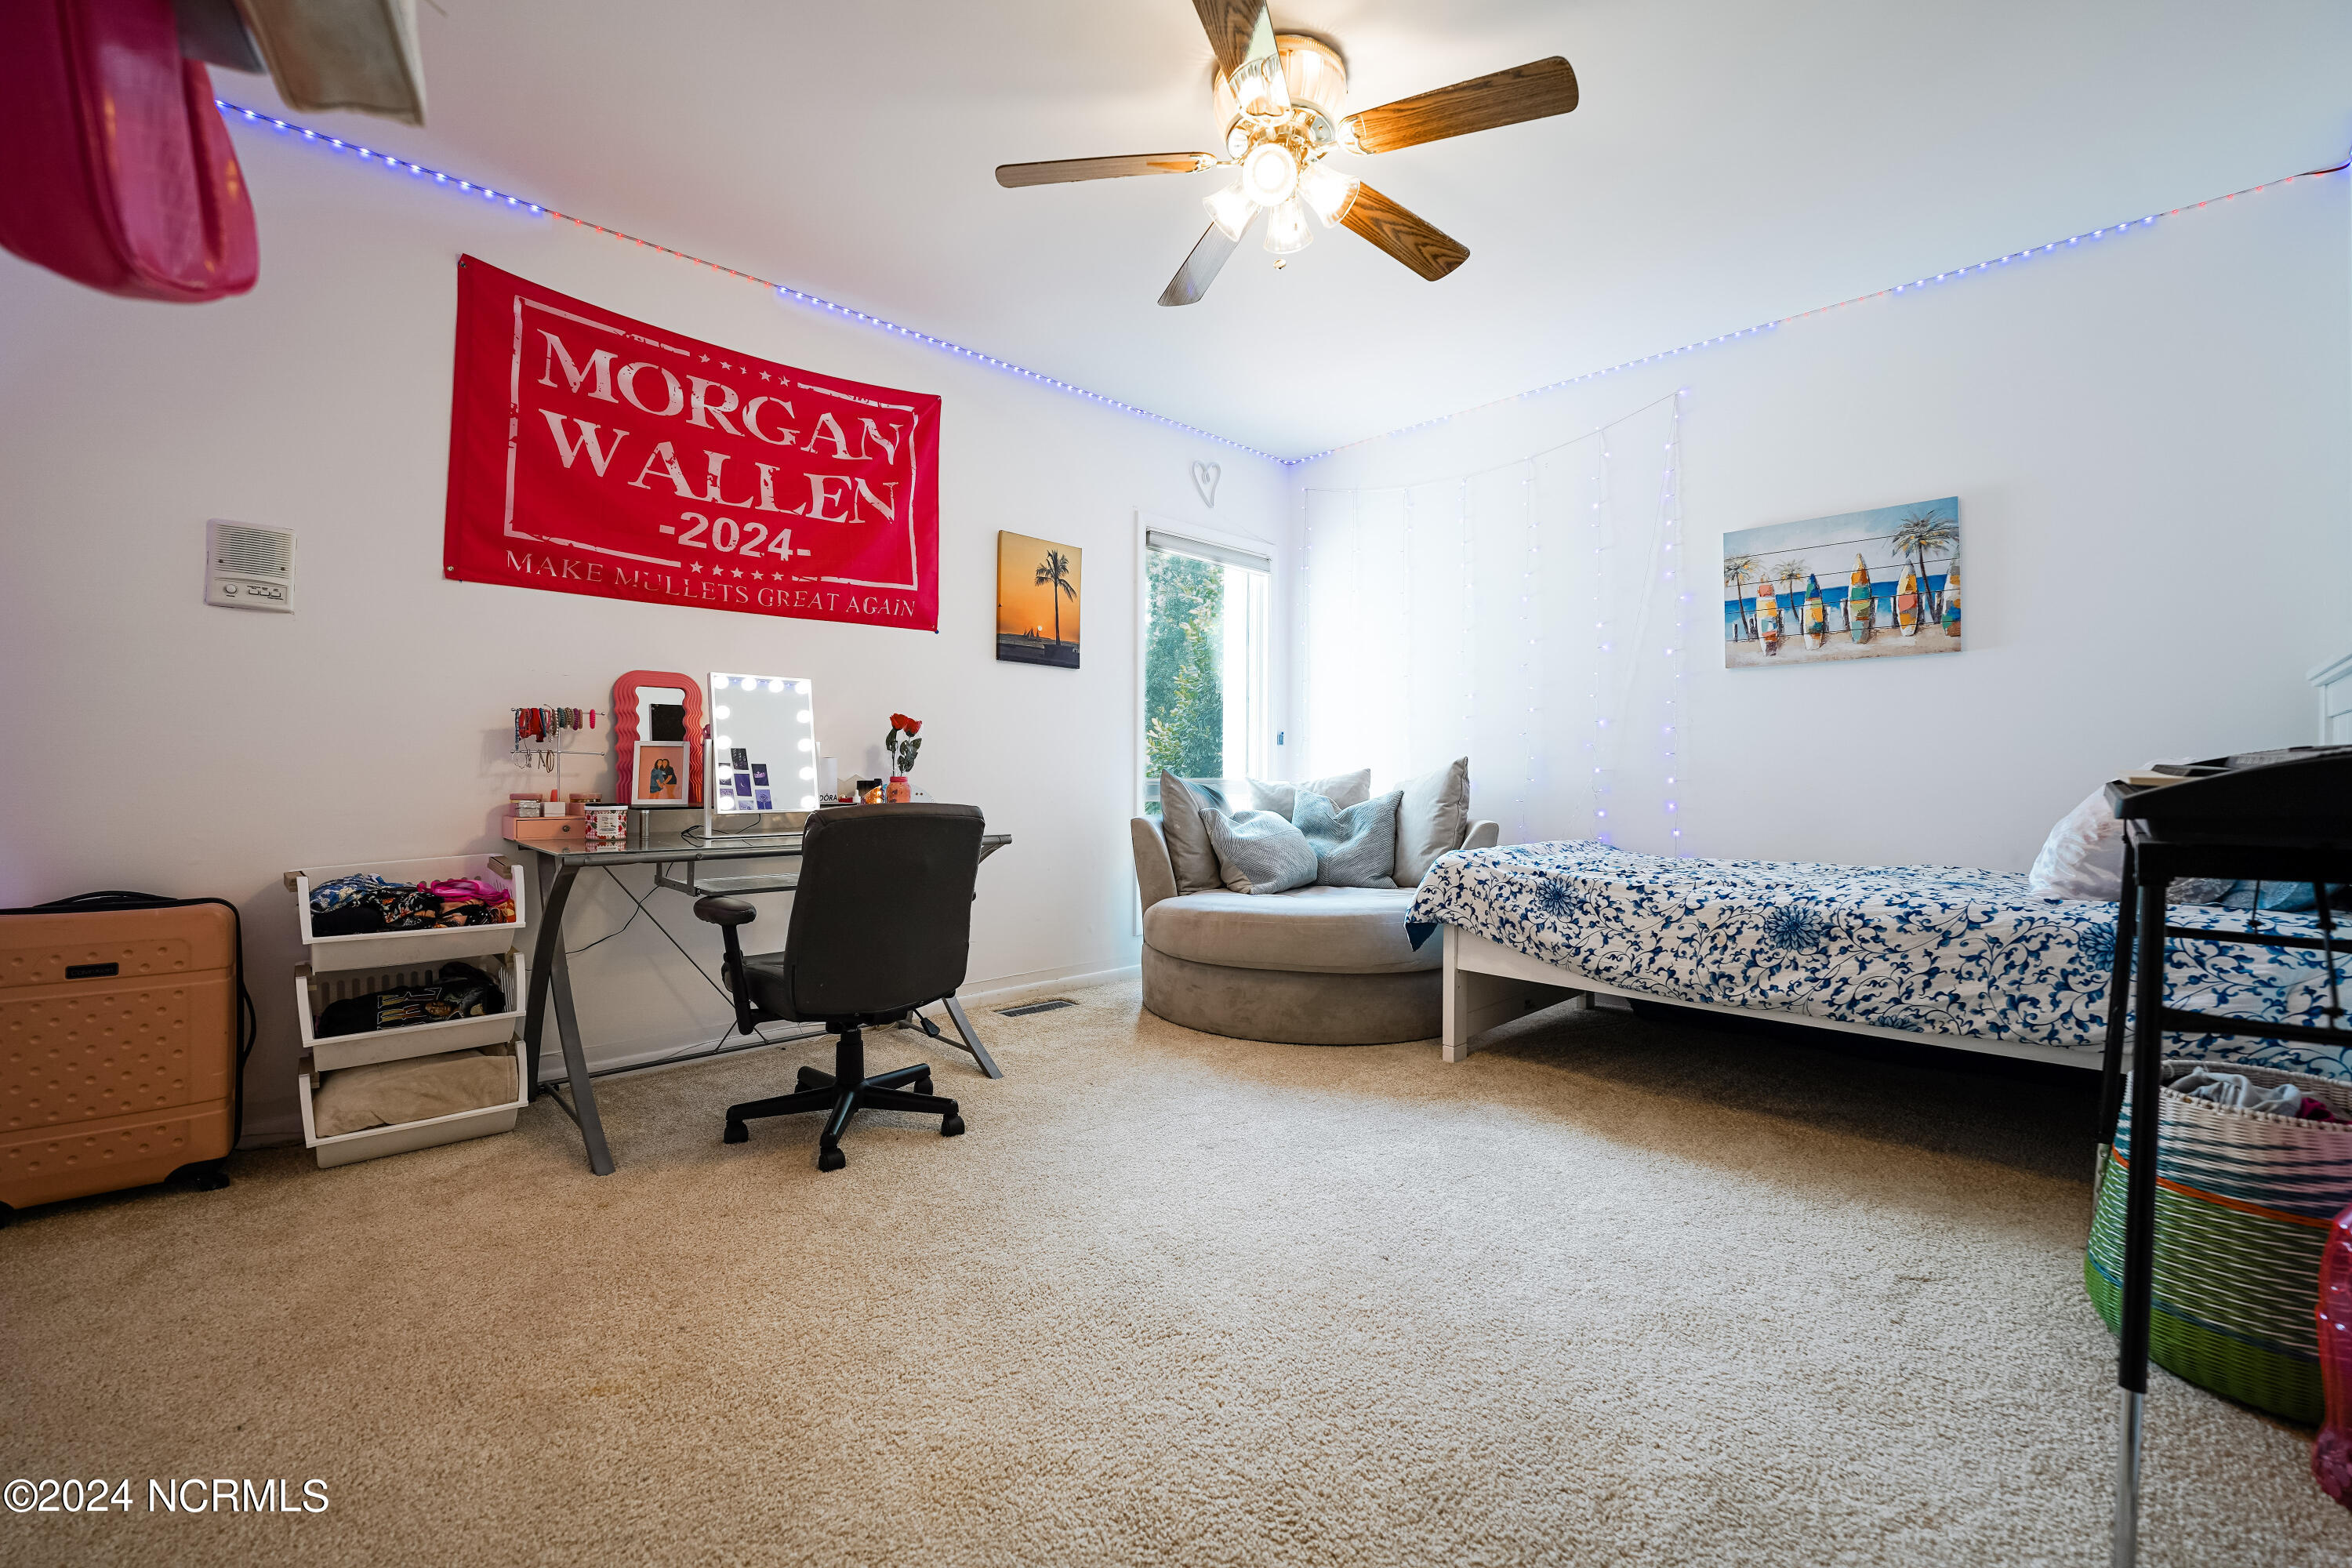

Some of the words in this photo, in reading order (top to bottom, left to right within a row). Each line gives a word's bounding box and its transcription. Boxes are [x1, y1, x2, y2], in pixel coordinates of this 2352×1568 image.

[537, 329, 904, 466] MORGAN
[539, 408, 900, 524] WALLEN
[659, 512, 811, 562] -2024-
[506, 550, 603, 583] MAKE
[615, 567, 749, 604] MULLETS
[758, 587, 840, 612] GREAT
[846, 596, 916, 618] AGAIN
